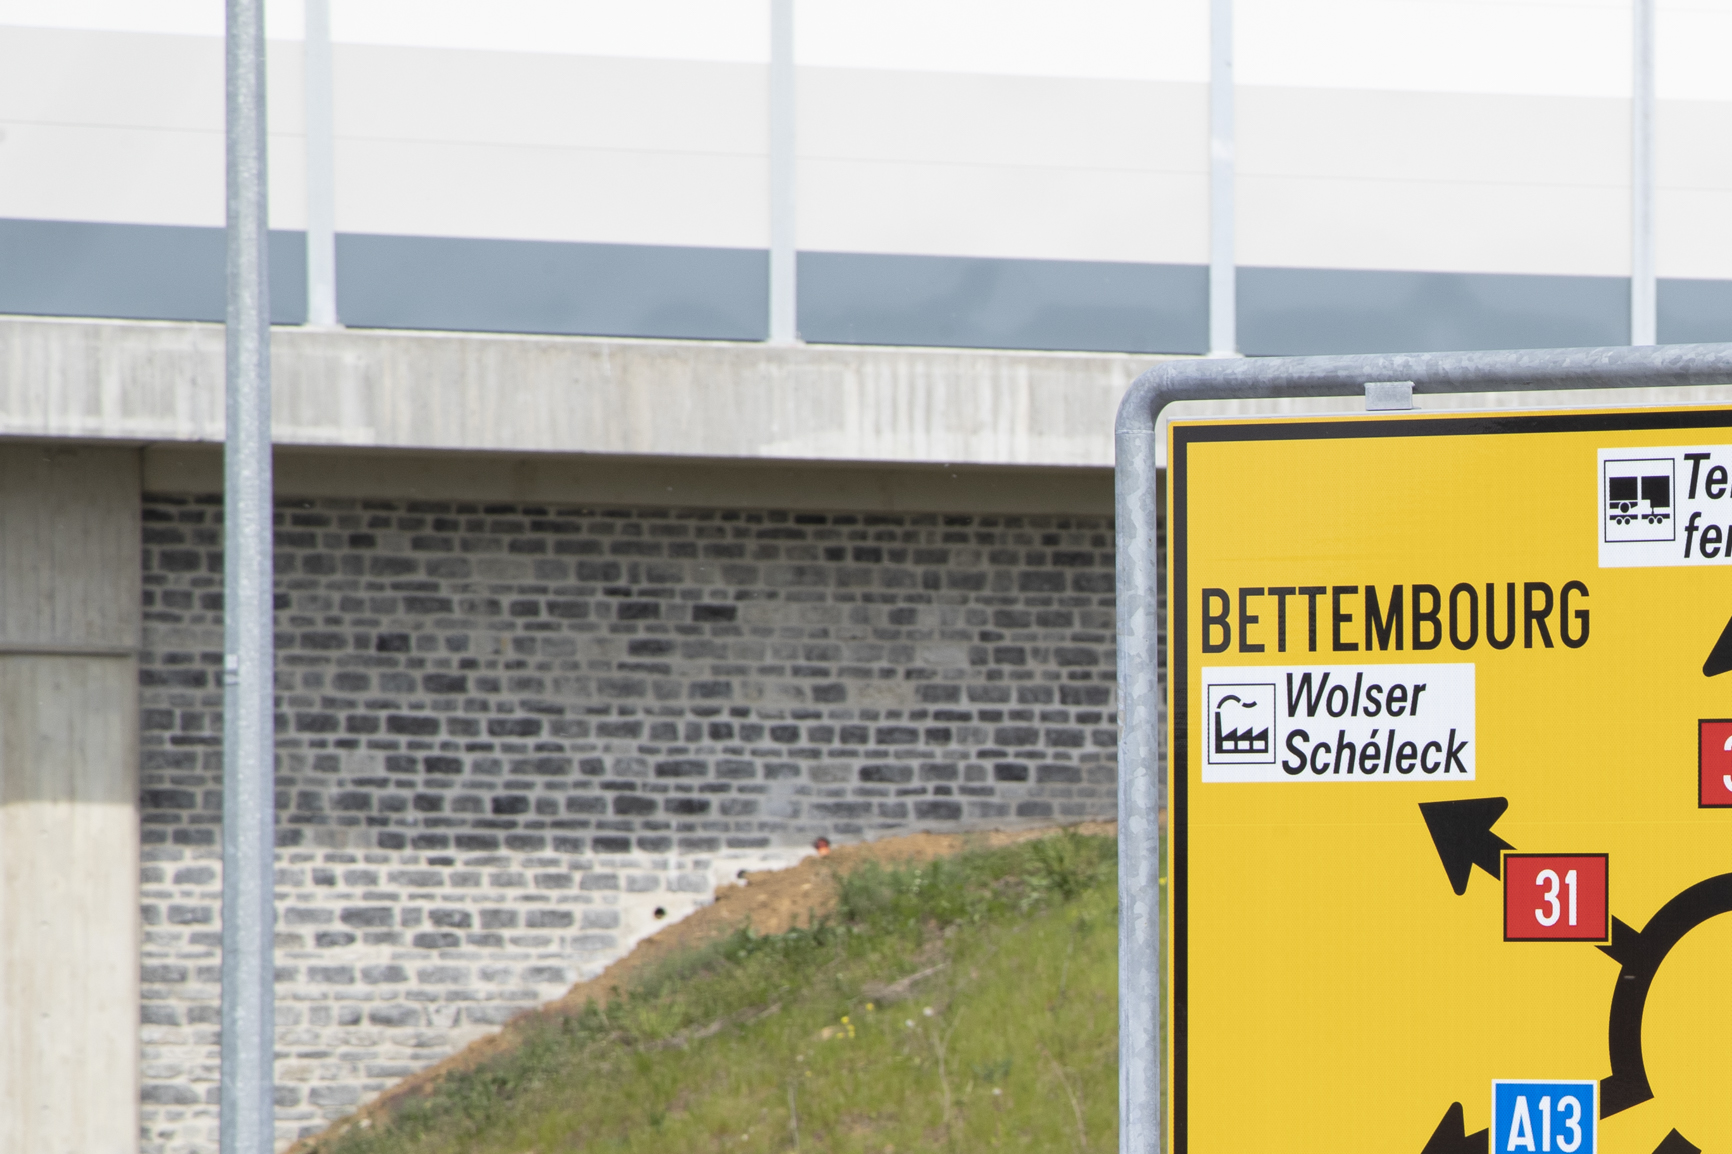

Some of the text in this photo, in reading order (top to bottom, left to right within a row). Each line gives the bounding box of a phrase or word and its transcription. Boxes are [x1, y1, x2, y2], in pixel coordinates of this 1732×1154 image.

[1201, 580, 1591, 654] BETTEMBOURG
[1285, 672, 1427, 718] Wolser
[1282, 728, 1469, 775] Schéleck
[1534, 869, 1578, 927] 31
[1506, 1095, 1583, 1154] A13
